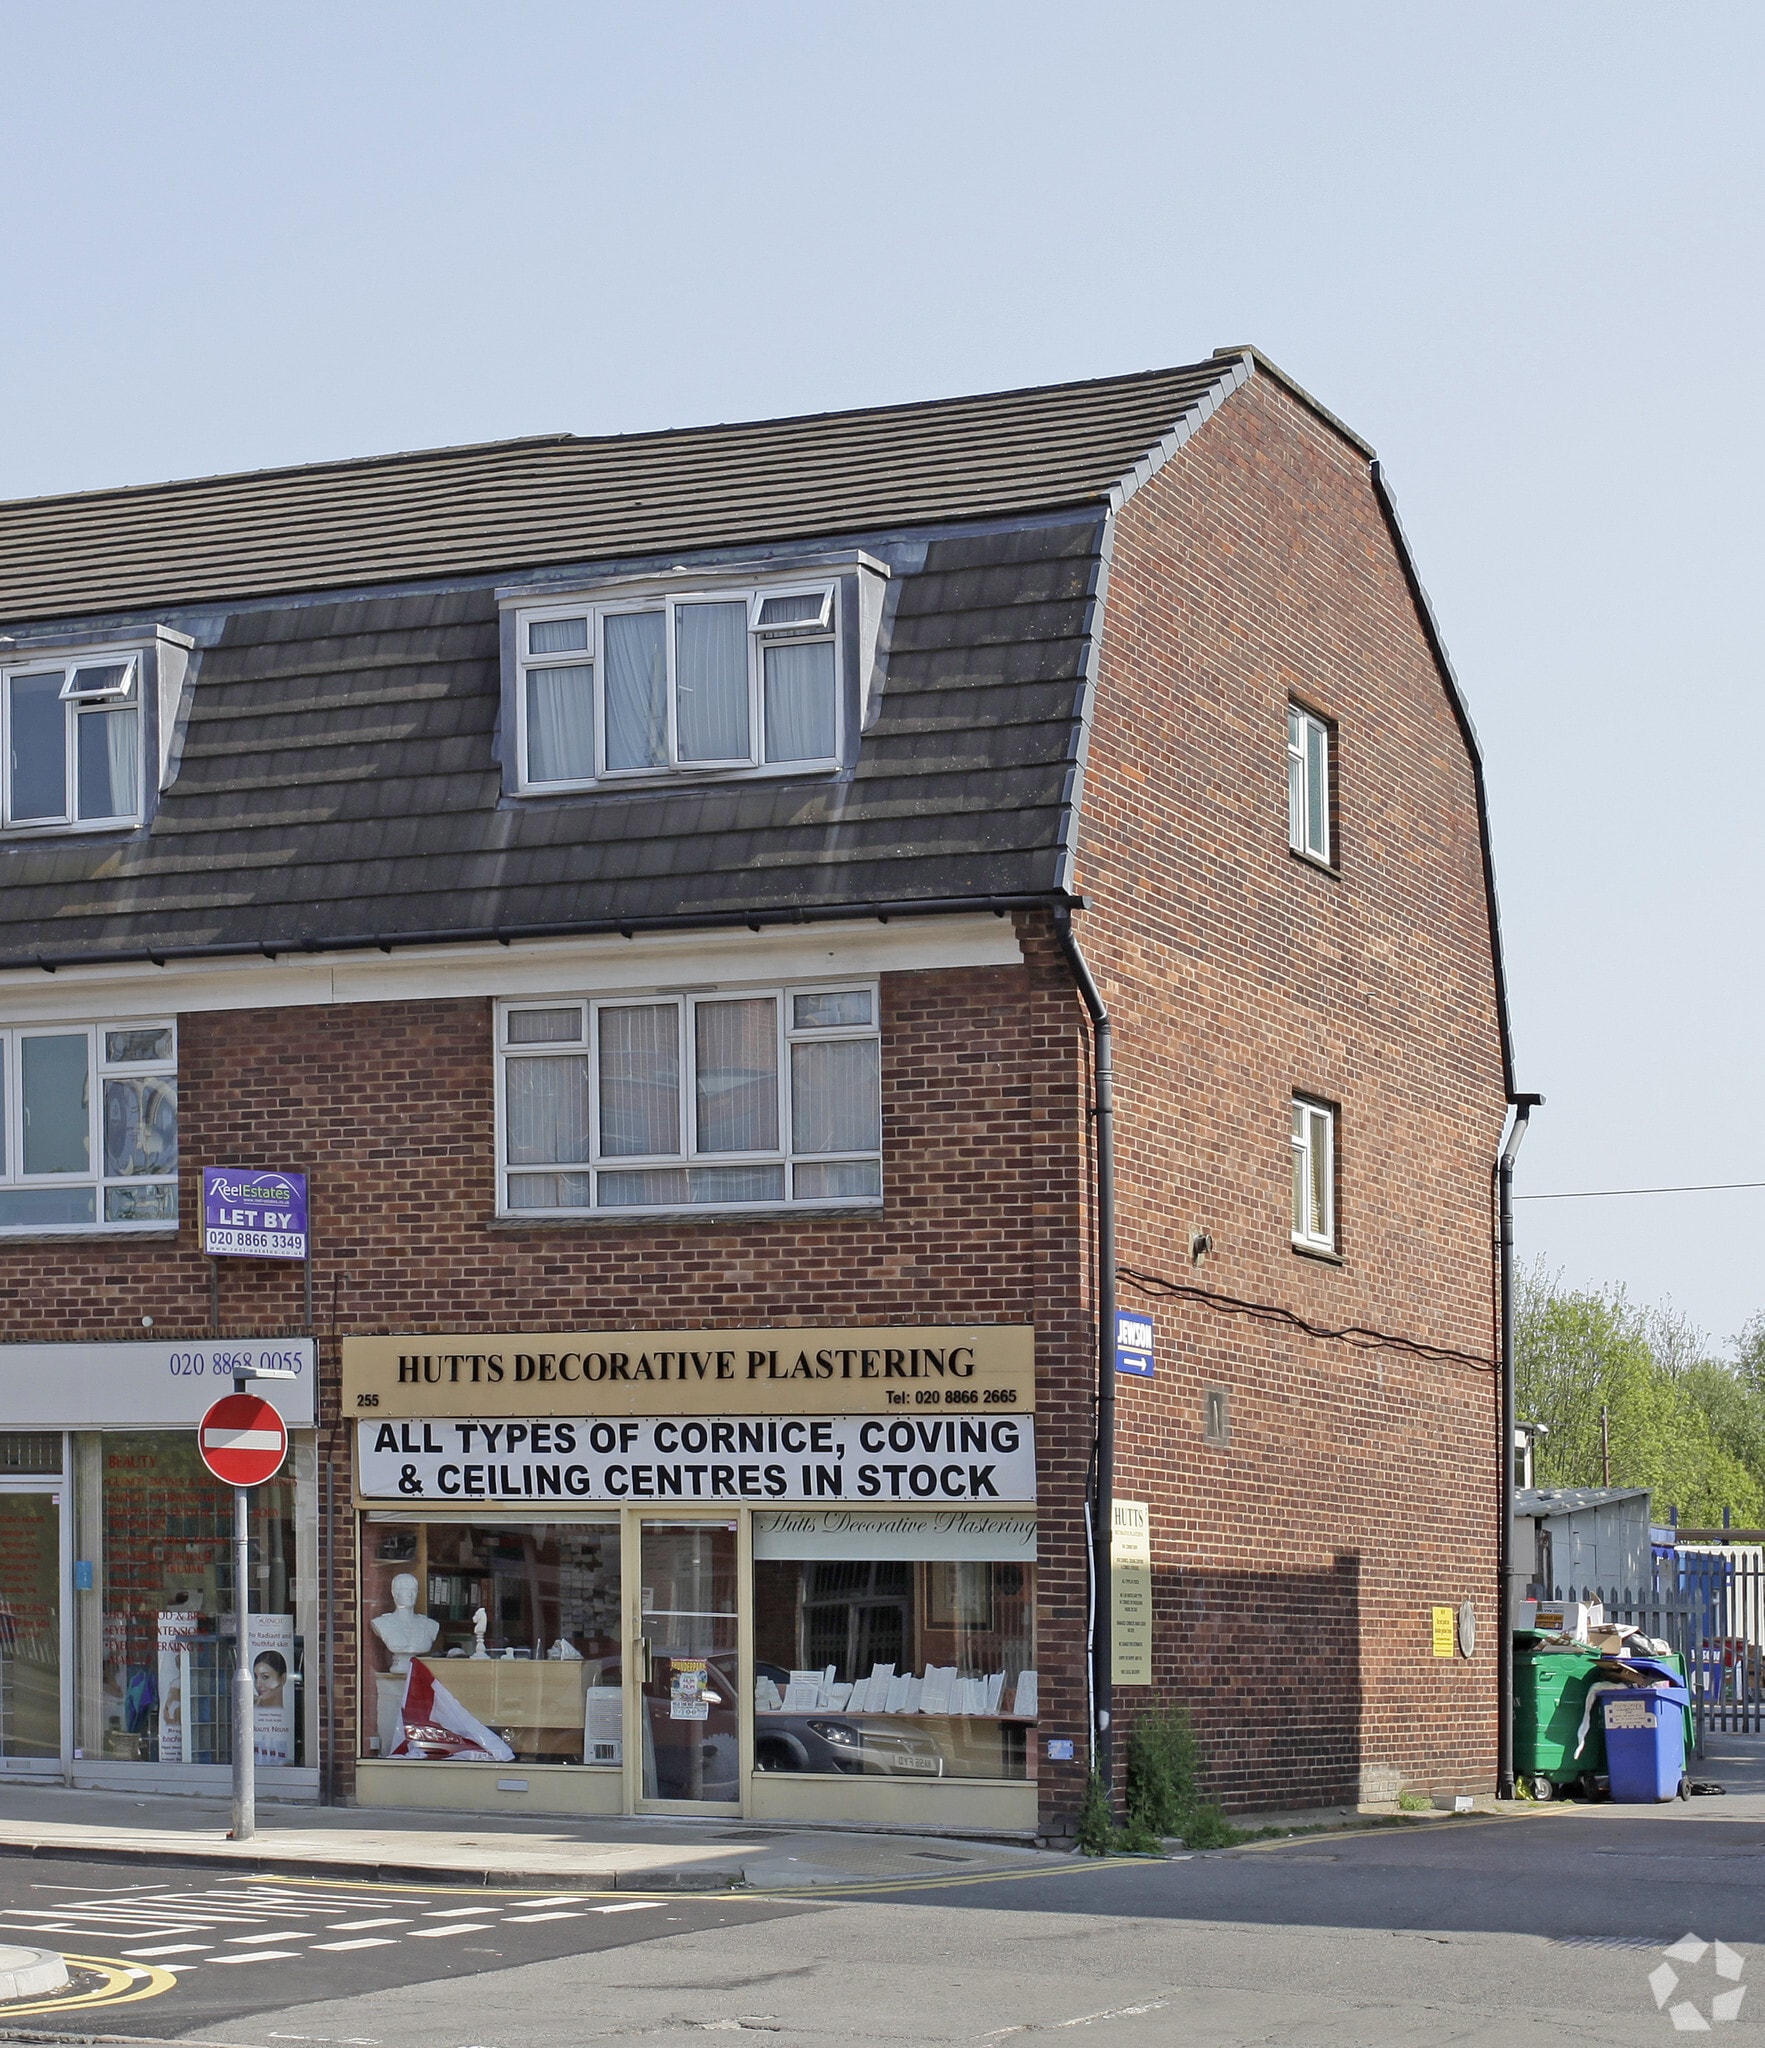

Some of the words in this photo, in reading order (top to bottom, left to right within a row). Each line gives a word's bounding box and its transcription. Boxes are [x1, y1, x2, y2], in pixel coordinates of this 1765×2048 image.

[219, 1208, 258, 1227] LET
[264, 1211, 292, 1230] BY
[210, 1231, 233, 1245] 020
[237, 1232, 268, 1248] 8866
[272, 1234, 302, 1250] 3349
[1117, 1319, 1152, 1349] JEWSON
[170, 1353, 204, 1376] 020
[212, 1352, 252, 1375] 8868
[260, 1351, 302, 1374] 0055
[397, 1354, 504, 1383] HUTTS
[513, 1350, 736, 1382] DECORATIVE
[746, 1347, 975, 1380] PLASTERING
[357, 1393, 379, 1408] 255
[886, 1390, 910, 1405] Tel:
[915, 1390, 940, 1405] 020
[945, 1389, 978, 1404] 8866
[983, 1389, 1017, 1404] 2665
[374, 1423, 443, 1453] ALL
[455, 1423, 576, 1454] TYPES
[589, 1422, 639, 1454] OF
[653, 1421, 846, 1461] CORNICE,
[859, 1421, 1020, 1453] COVING
[108, 1455, 156, 1469] BEAUTY
[398, 1464, 424, 1494] &
[437, 1464, 590, 1496] CEILING
[604, 1464, 788, 1496] CENTRES
[802, 1464, 843, 1496] IN
[857, 1464, 1000, 1497] STOCK
[1114, 1506, 1144, 1528] HUTTS
[760, 1512, 817, 1534] Hutts
[821, 1512, 928, 1534] Decorative
[933, 1512, 1038, 1547] Plastering
